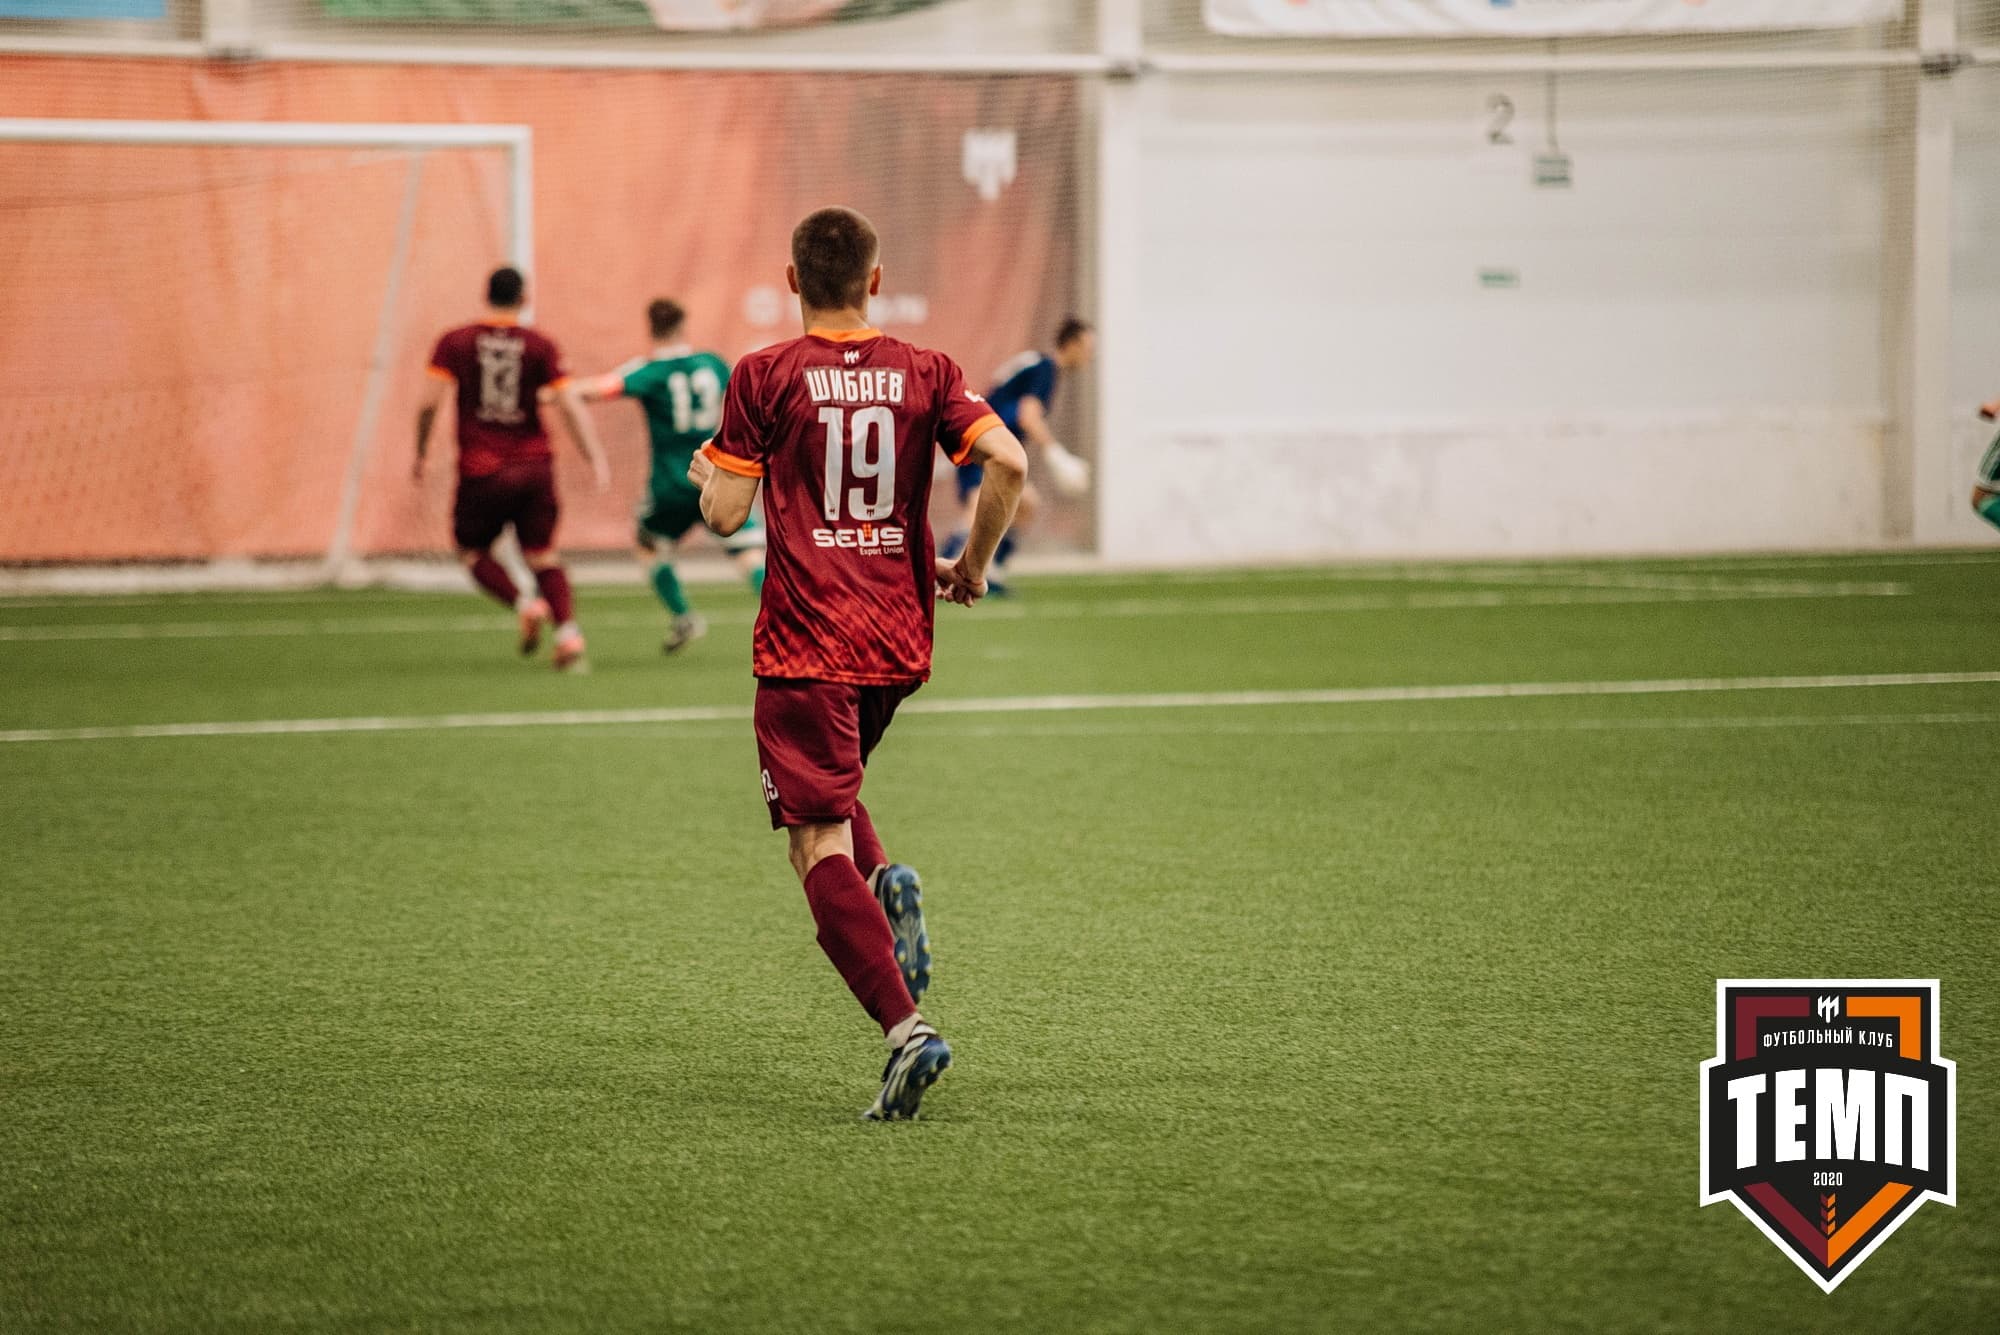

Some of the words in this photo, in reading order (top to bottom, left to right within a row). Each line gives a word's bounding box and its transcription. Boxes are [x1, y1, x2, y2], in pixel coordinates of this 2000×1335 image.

[1486, 94, 1515, 145] 2
[668, 367, 721, 433] 13
[806, 368, 903, 402] ШИБАЕВ
[818, 406, 895, 521] 19
[883, 546, 904, 555] Union
